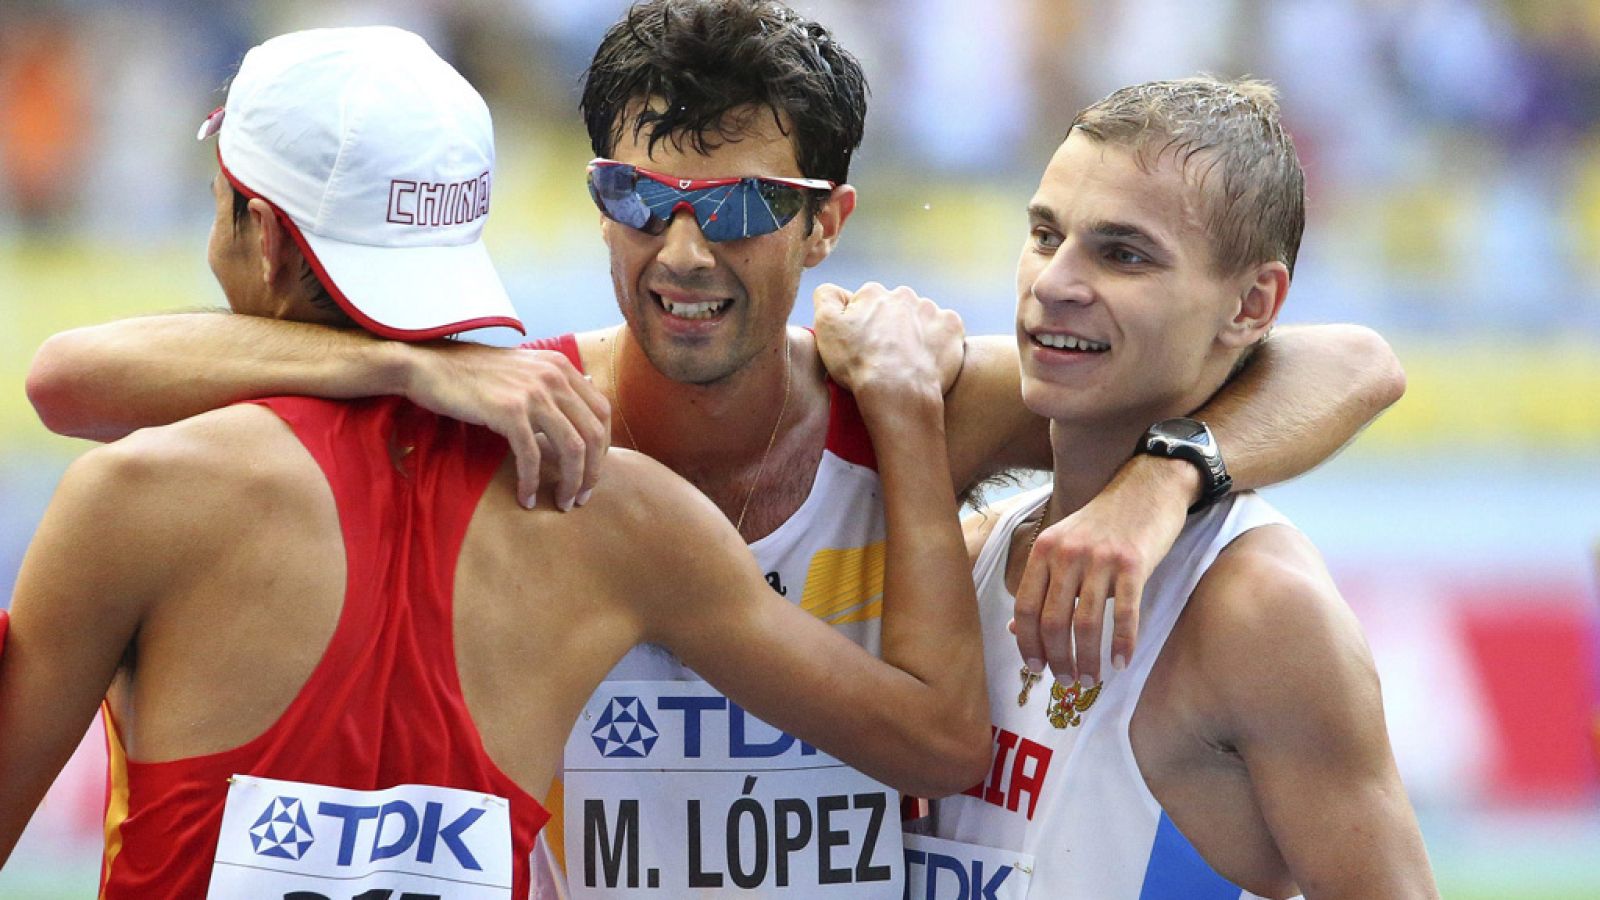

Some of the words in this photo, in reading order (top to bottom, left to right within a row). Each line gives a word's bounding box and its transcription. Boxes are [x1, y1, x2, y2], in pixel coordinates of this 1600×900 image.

[386, 170, 490, 226] CHINA
[656, 696, 817, 759] TD
[317, 799, 487, 871] TDK
[583, 798, 661, 889] M.
[686, 774, 892, 890] LÓPEZ
